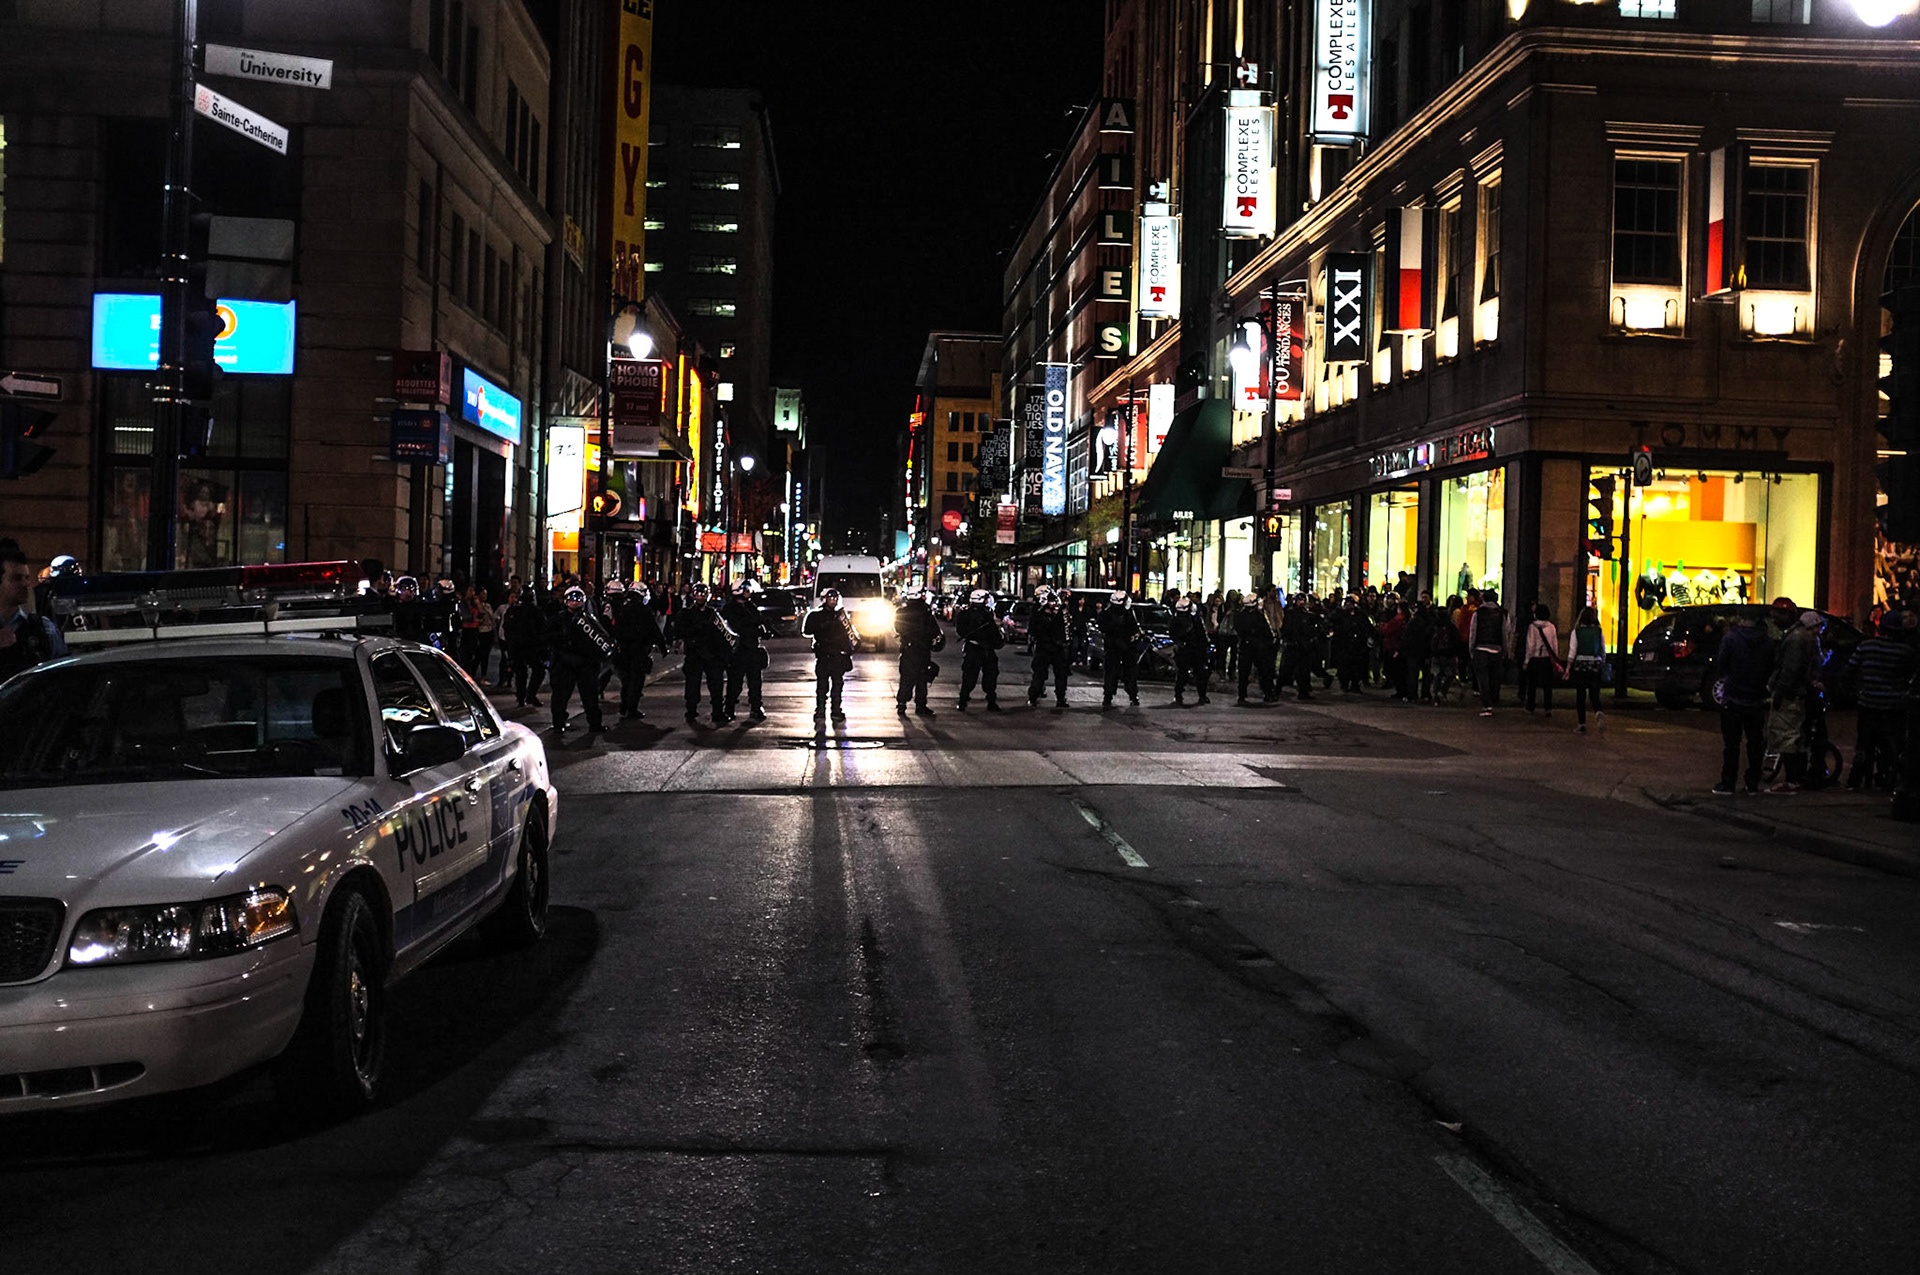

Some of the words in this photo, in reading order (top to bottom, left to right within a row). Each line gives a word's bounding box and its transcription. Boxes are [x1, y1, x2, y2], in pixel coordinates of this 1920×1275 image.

[240, 59, 322, 86] University
[1345, 59, 1355, 91] LES
[211, 102, 283, 149] Sainte-Catherine
[1251, 118, 1260, 163] AILES
[1237, 118, 1250, 194] COMPLEXE
[1250, 168, 1258, 194] LES
[1100, 102, 1130, 353] AILES
[1150, 225, 1160, 285] COMPLEXE
[1333, 268, 1362, 346] XXI
[1282, 303, 1292, 366] TENDANCES
[616, 376, 659, 387] PHOBIE
[617, 364, 659, 377] HOMO
[1047, 389, 1064, 432] OLD
[1630, 420, 1792, 451] TOMMY
[1045, 436, 1062, 488] NAVY
[577, 617, 610, 652] POLICE
[341, 797, 384, 831] 20-14
[394, 796, 468, 873] POLICE
